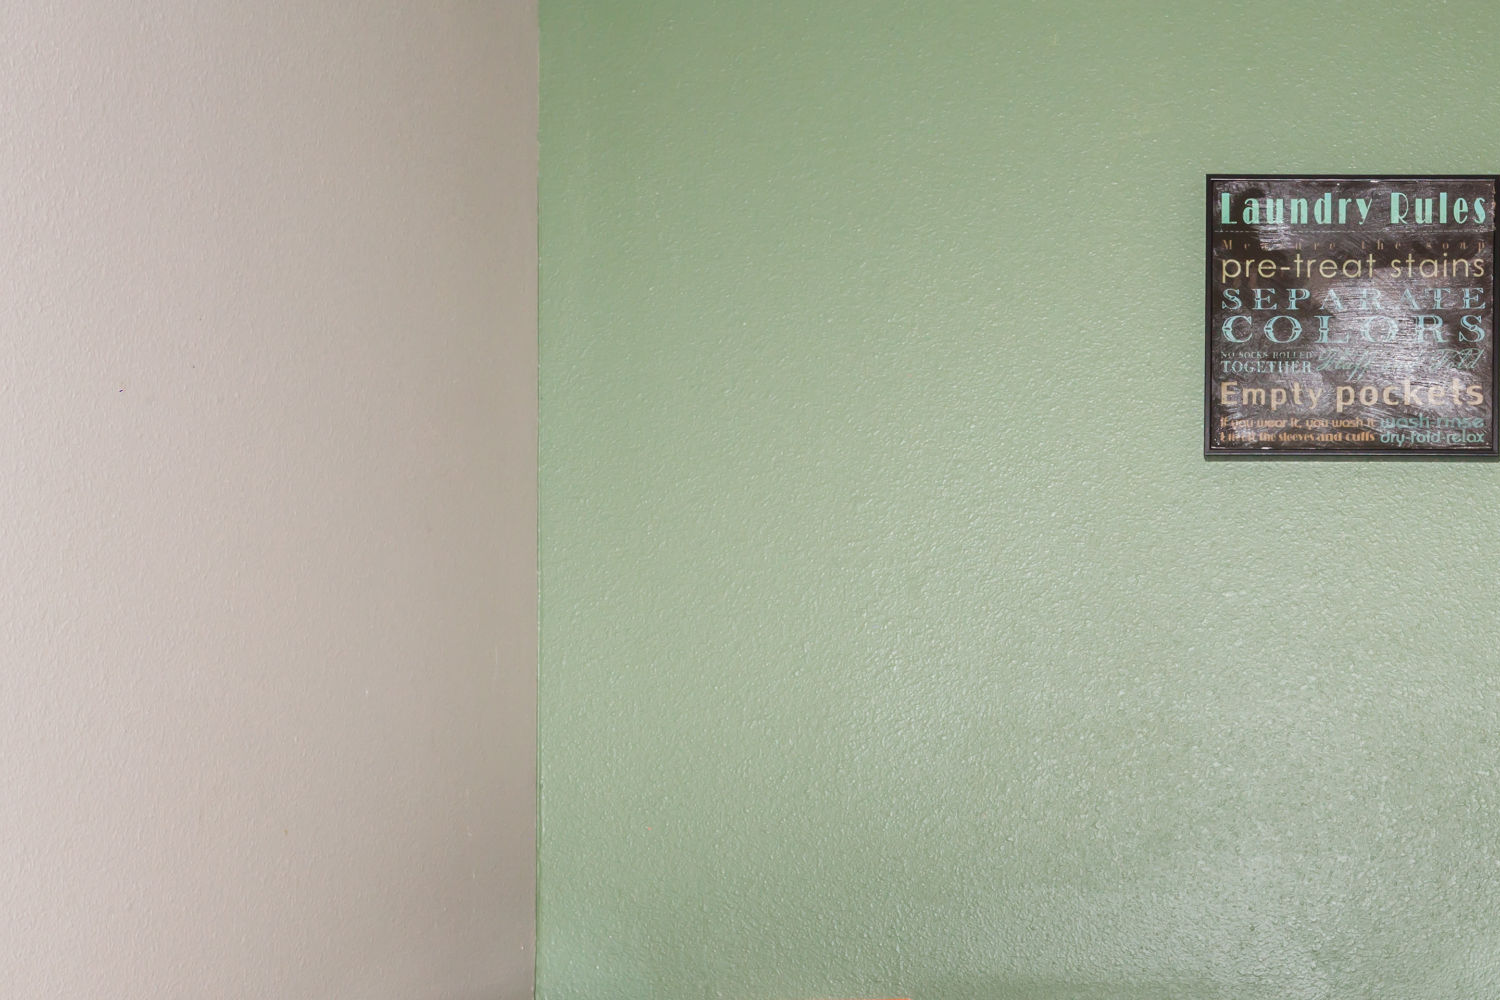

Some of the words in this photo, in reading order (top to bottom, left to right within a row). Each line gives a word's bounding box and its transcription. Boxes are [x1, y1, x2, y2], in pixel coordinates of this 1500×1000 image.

[1221, 192, 1373, 225] Laundry
[1390, 192, 1486, 224] Rules
[1222, 253, 1376, 284] pre-treat
[1390, 253, 1485, 278] stains
[1221, 287, 1486, 311] SEPARATE
[1221, 315, 1486, 344] COLORS
[1220, 360, 1311, 374] TOGETHER
[1220, 381, 1323, 410] Empty
[1336, 378, 1485, 413] pockets
[1331, 417, 1363, 428] wash
